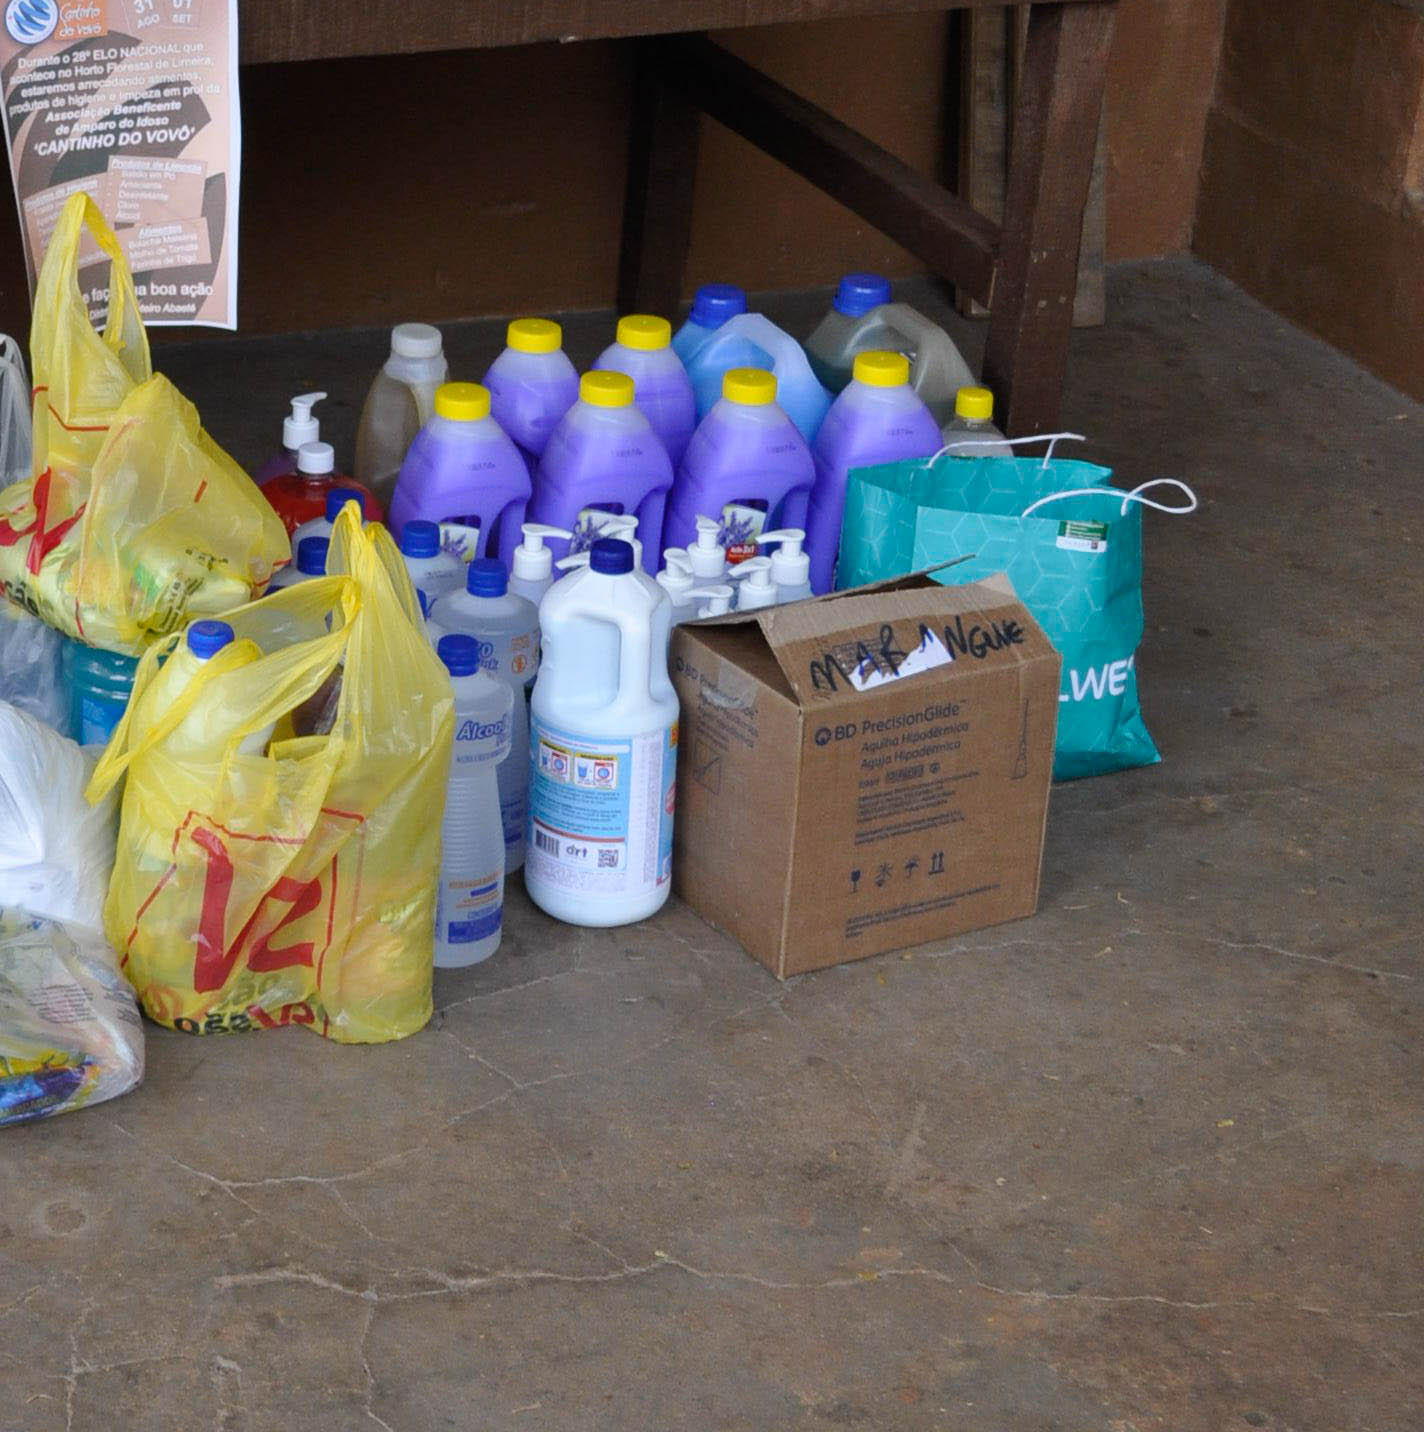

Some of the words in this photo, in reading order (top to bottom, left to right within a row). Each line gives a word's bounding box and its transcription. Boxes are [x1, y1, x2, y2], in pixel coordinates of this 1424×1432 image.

[137, 14, 160, 29] AGO
[18, 55, 61, 69] Durante
[93, 48, 118, 60] ELO
[120, 44, 181, 58] NACIONAL
[183, 43, 204, 54] que
[9, 70, 56, 85] acontece
[58, 69, 72, 79] no
[74, 64, 104, 76] Horto
[106, 59, 153, 74] Florestal
[155, 58, 169, 68] de
[21, 82, 76, 98] estaremos
[77, 76, 145, 90] arrecadando
[9, 99, 50, 117] produtos
[52, 97, 66, 108] de
[67, 91, 106, 107] higiene
[119, 87, 161, 103] limpeza
[163, 87, 181, 97] em
[182, 84, 203, 98] prol
[44, 106, 111, 123] Associação
[113, 99, 182, 115] Beneficente
[54, 125, 70, 136] de
[70, 120, 117, 136] Amparo
[118, 117, 134, 129] do
[136, 115, 170, 127] Idoso
[118, 131, 143, 145] DO
[91, 287, 111, 303] faç
[150, 282, 177, 296] boa
[180, 282, 214, 298] ação
[834, 724, 857, 742] BD
[861, 704, 961, 736] PrecisionGlide
